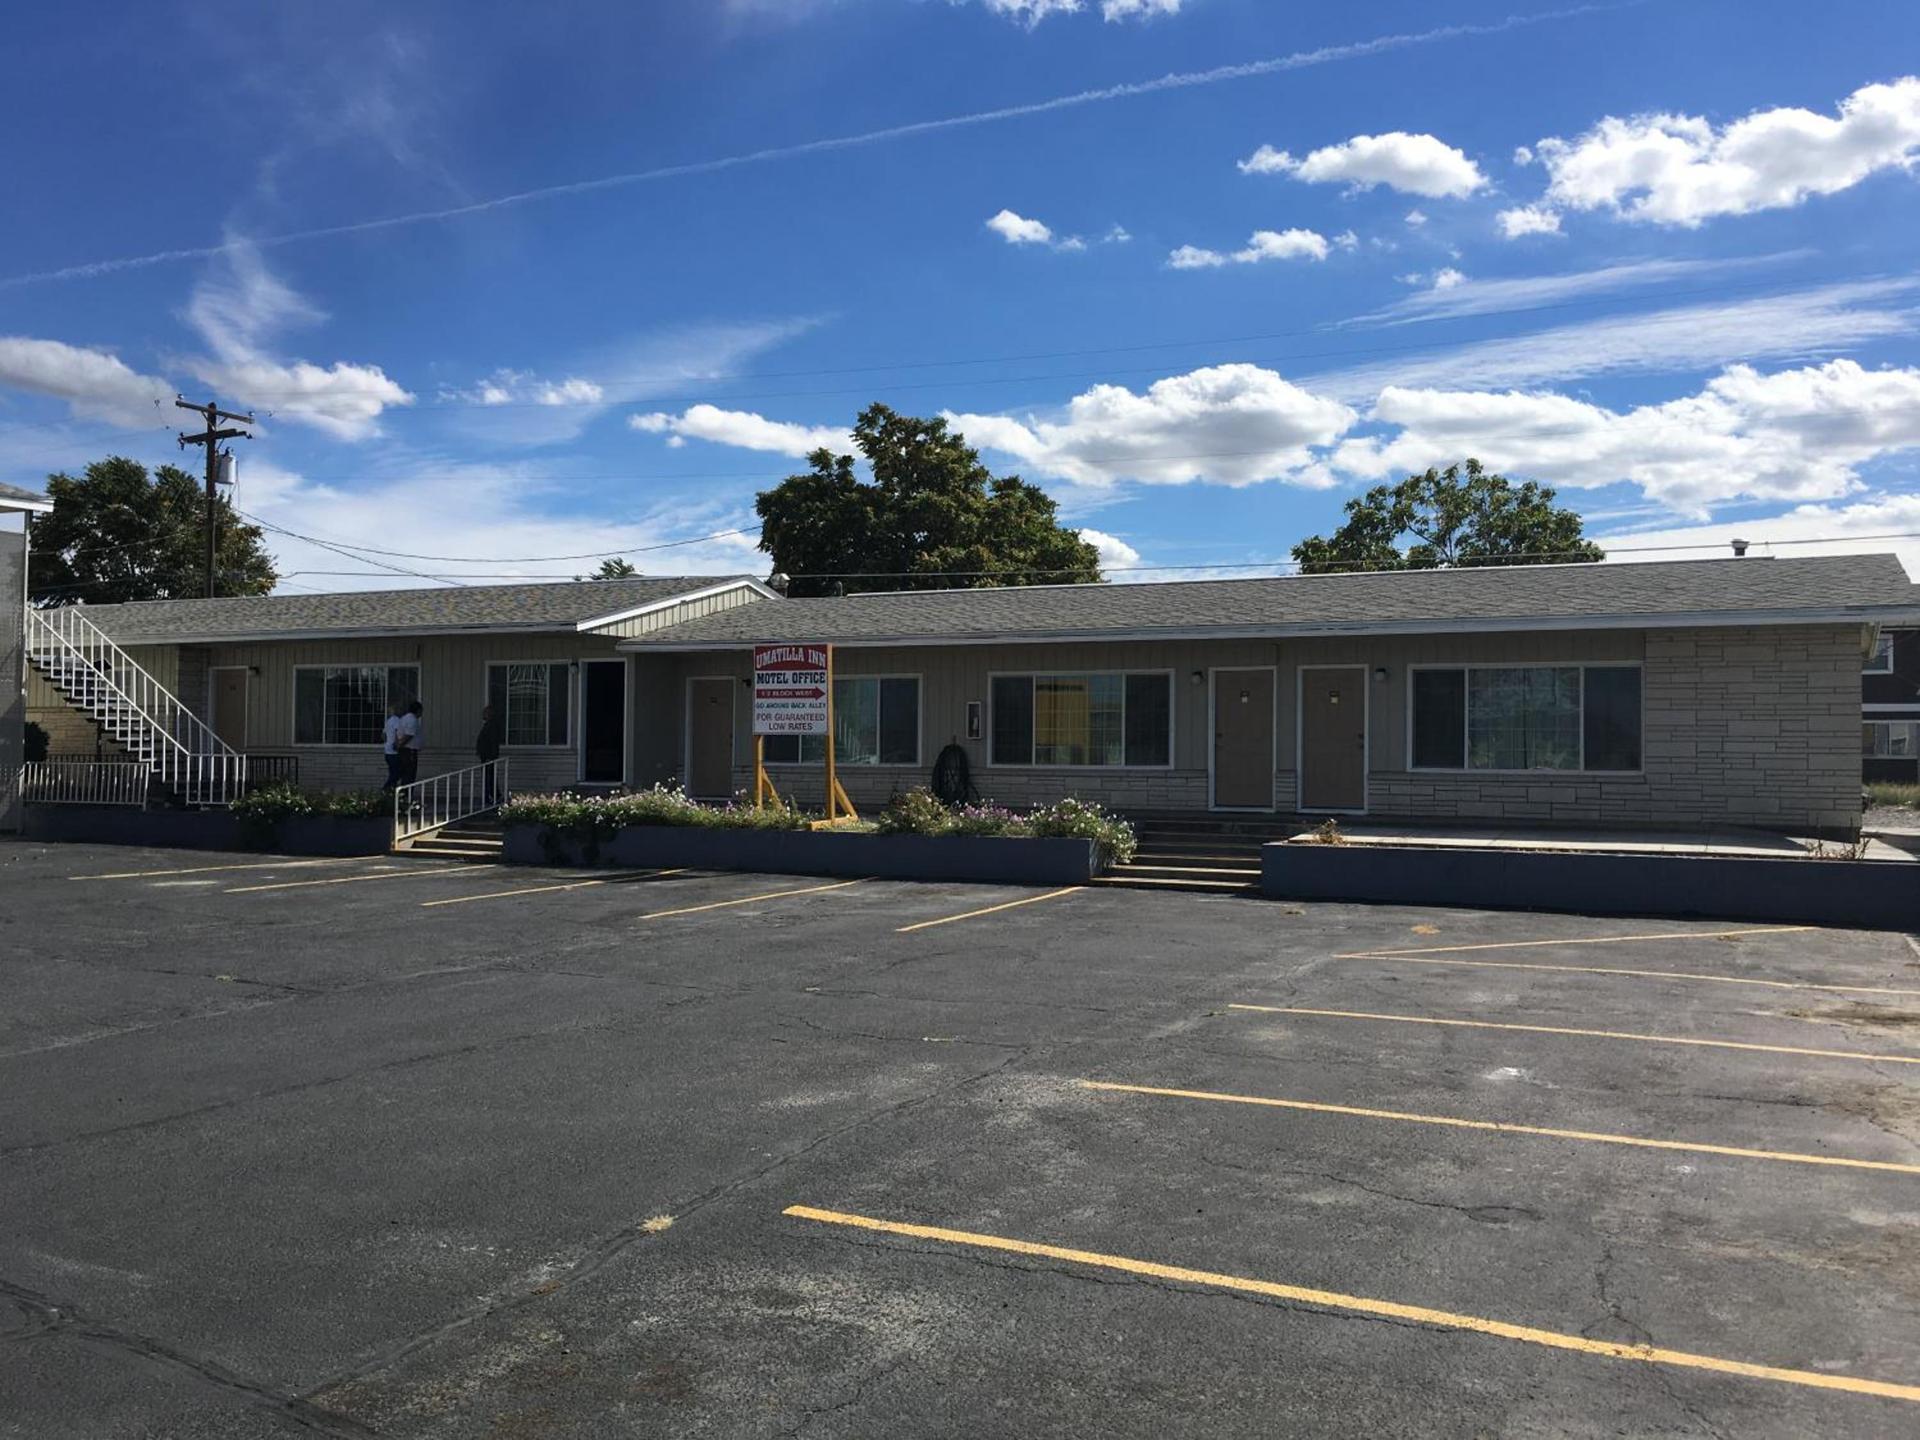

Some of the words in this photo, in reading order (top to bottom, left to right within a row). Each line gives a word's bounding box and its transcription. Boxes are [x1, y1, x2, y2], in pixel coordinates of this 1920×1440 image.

[756, 647, 804, 669] UMATILLA
[808, 649, 826, 668] INN
[756, 672, 788, 684] MOTEL
[791, 672, 826, 684] OFFICE
[756, 712, 772, 722] FOR
[774, 712, 826, 722] GUARANTEED
[768, 722, 786, 731] LOW
[787, 722, 814, 731] RATES
